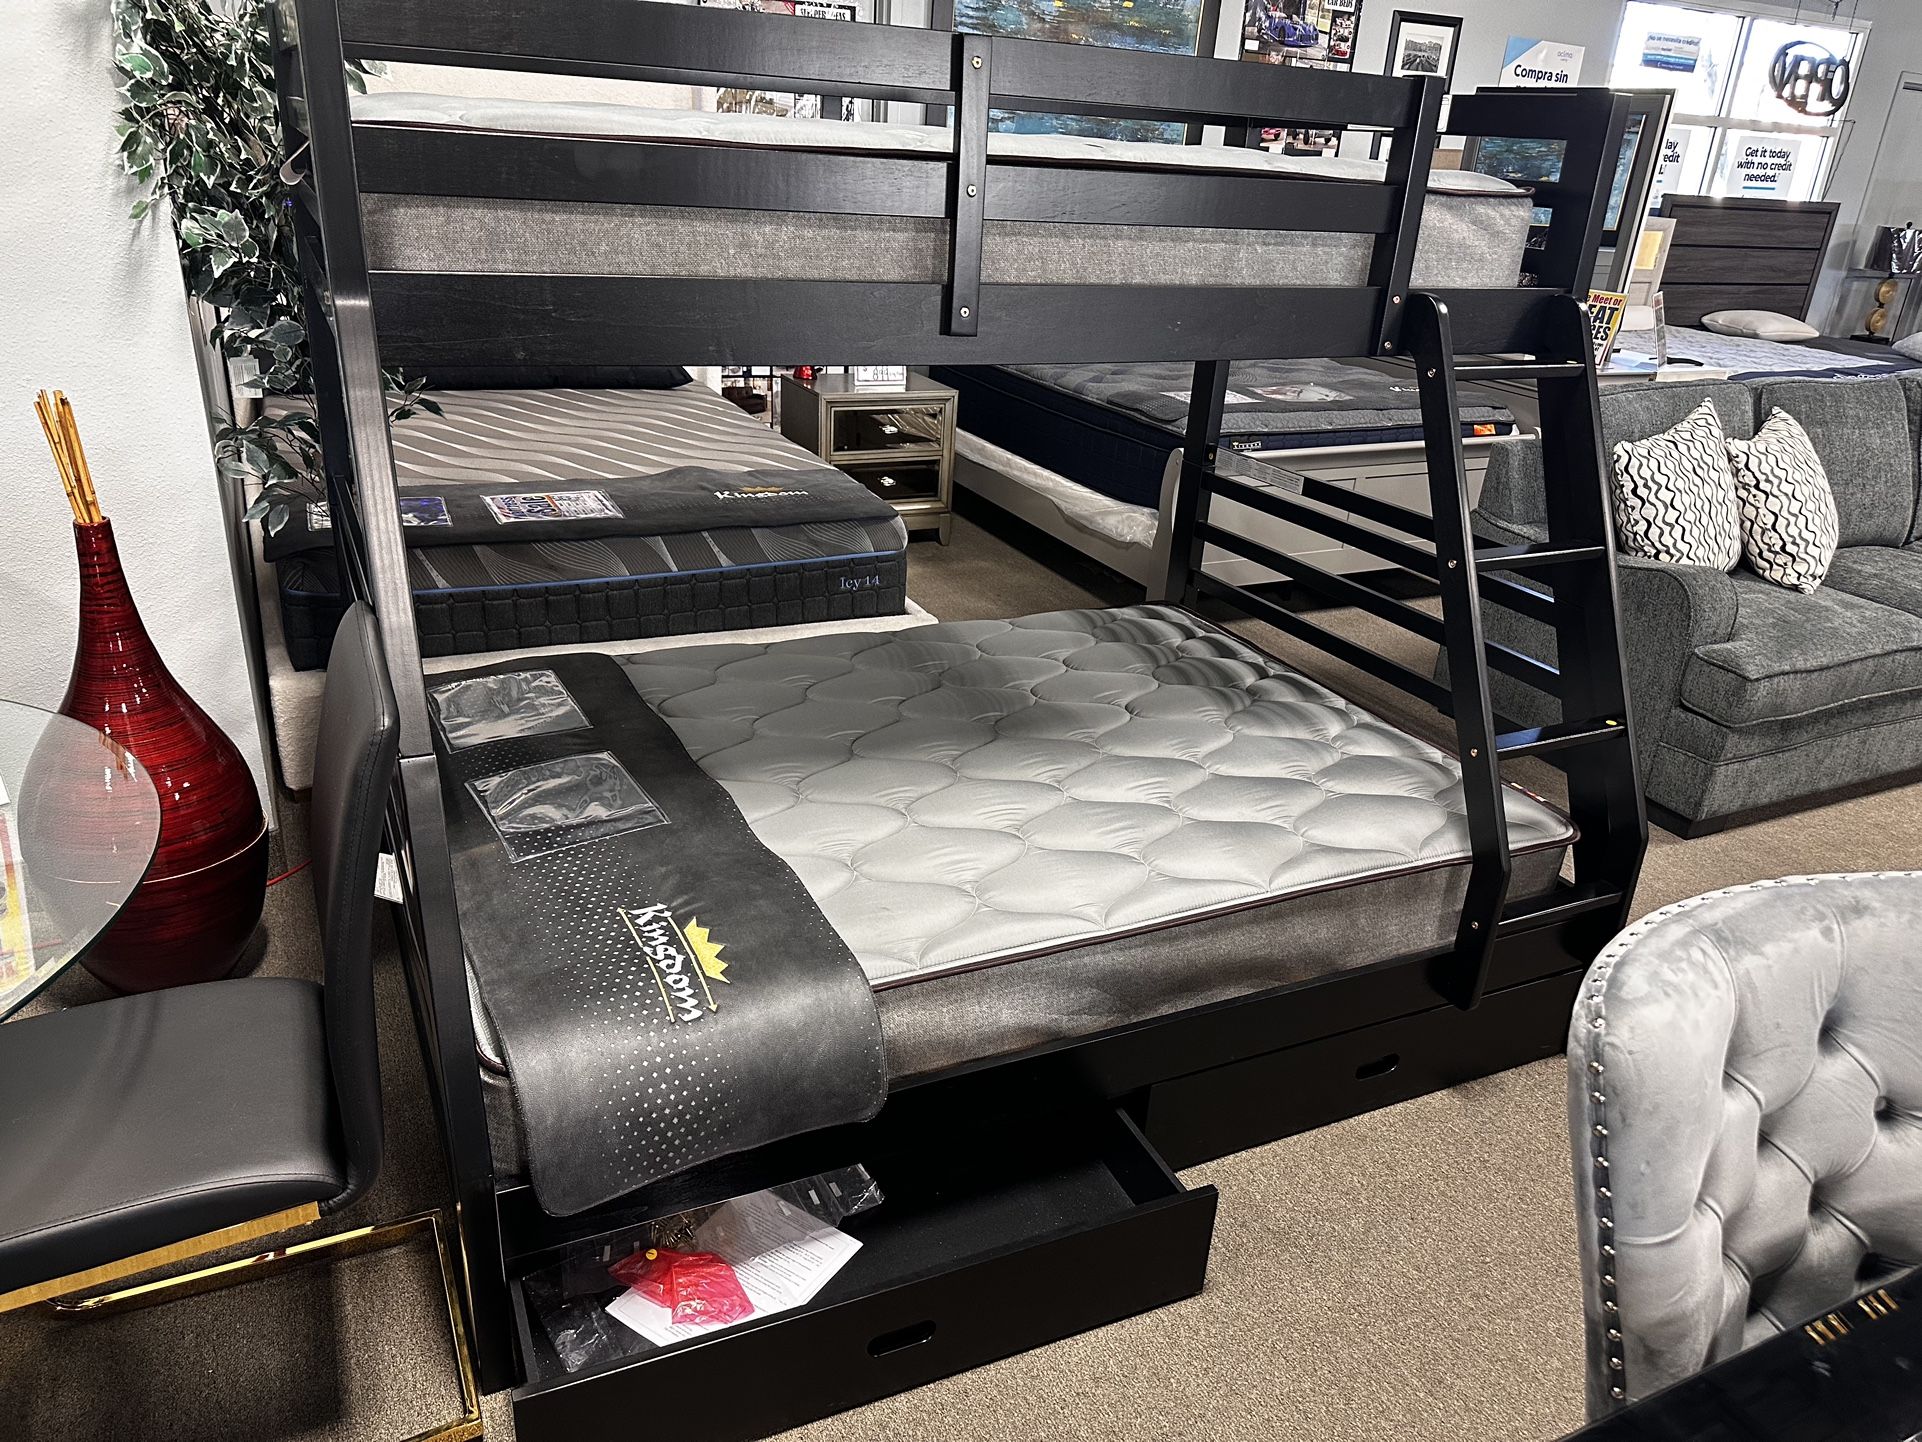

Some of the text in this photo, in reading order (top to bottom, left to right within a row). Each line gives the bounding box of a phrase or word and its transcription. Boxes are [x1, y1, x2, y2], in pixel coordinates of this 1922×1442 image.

[1514, 64, 1568, 84] Compra sin
[1745, 146, 1791, 161] Get it today
[1737, 158, 1792, 172] with no credit
[1592, 294, 1612, 305] Meet
[1589, 304, 1619, 325] EAT
[840, 574, 880, 590] Icy 14
[627, 903, 703, 1022] Kingdom
